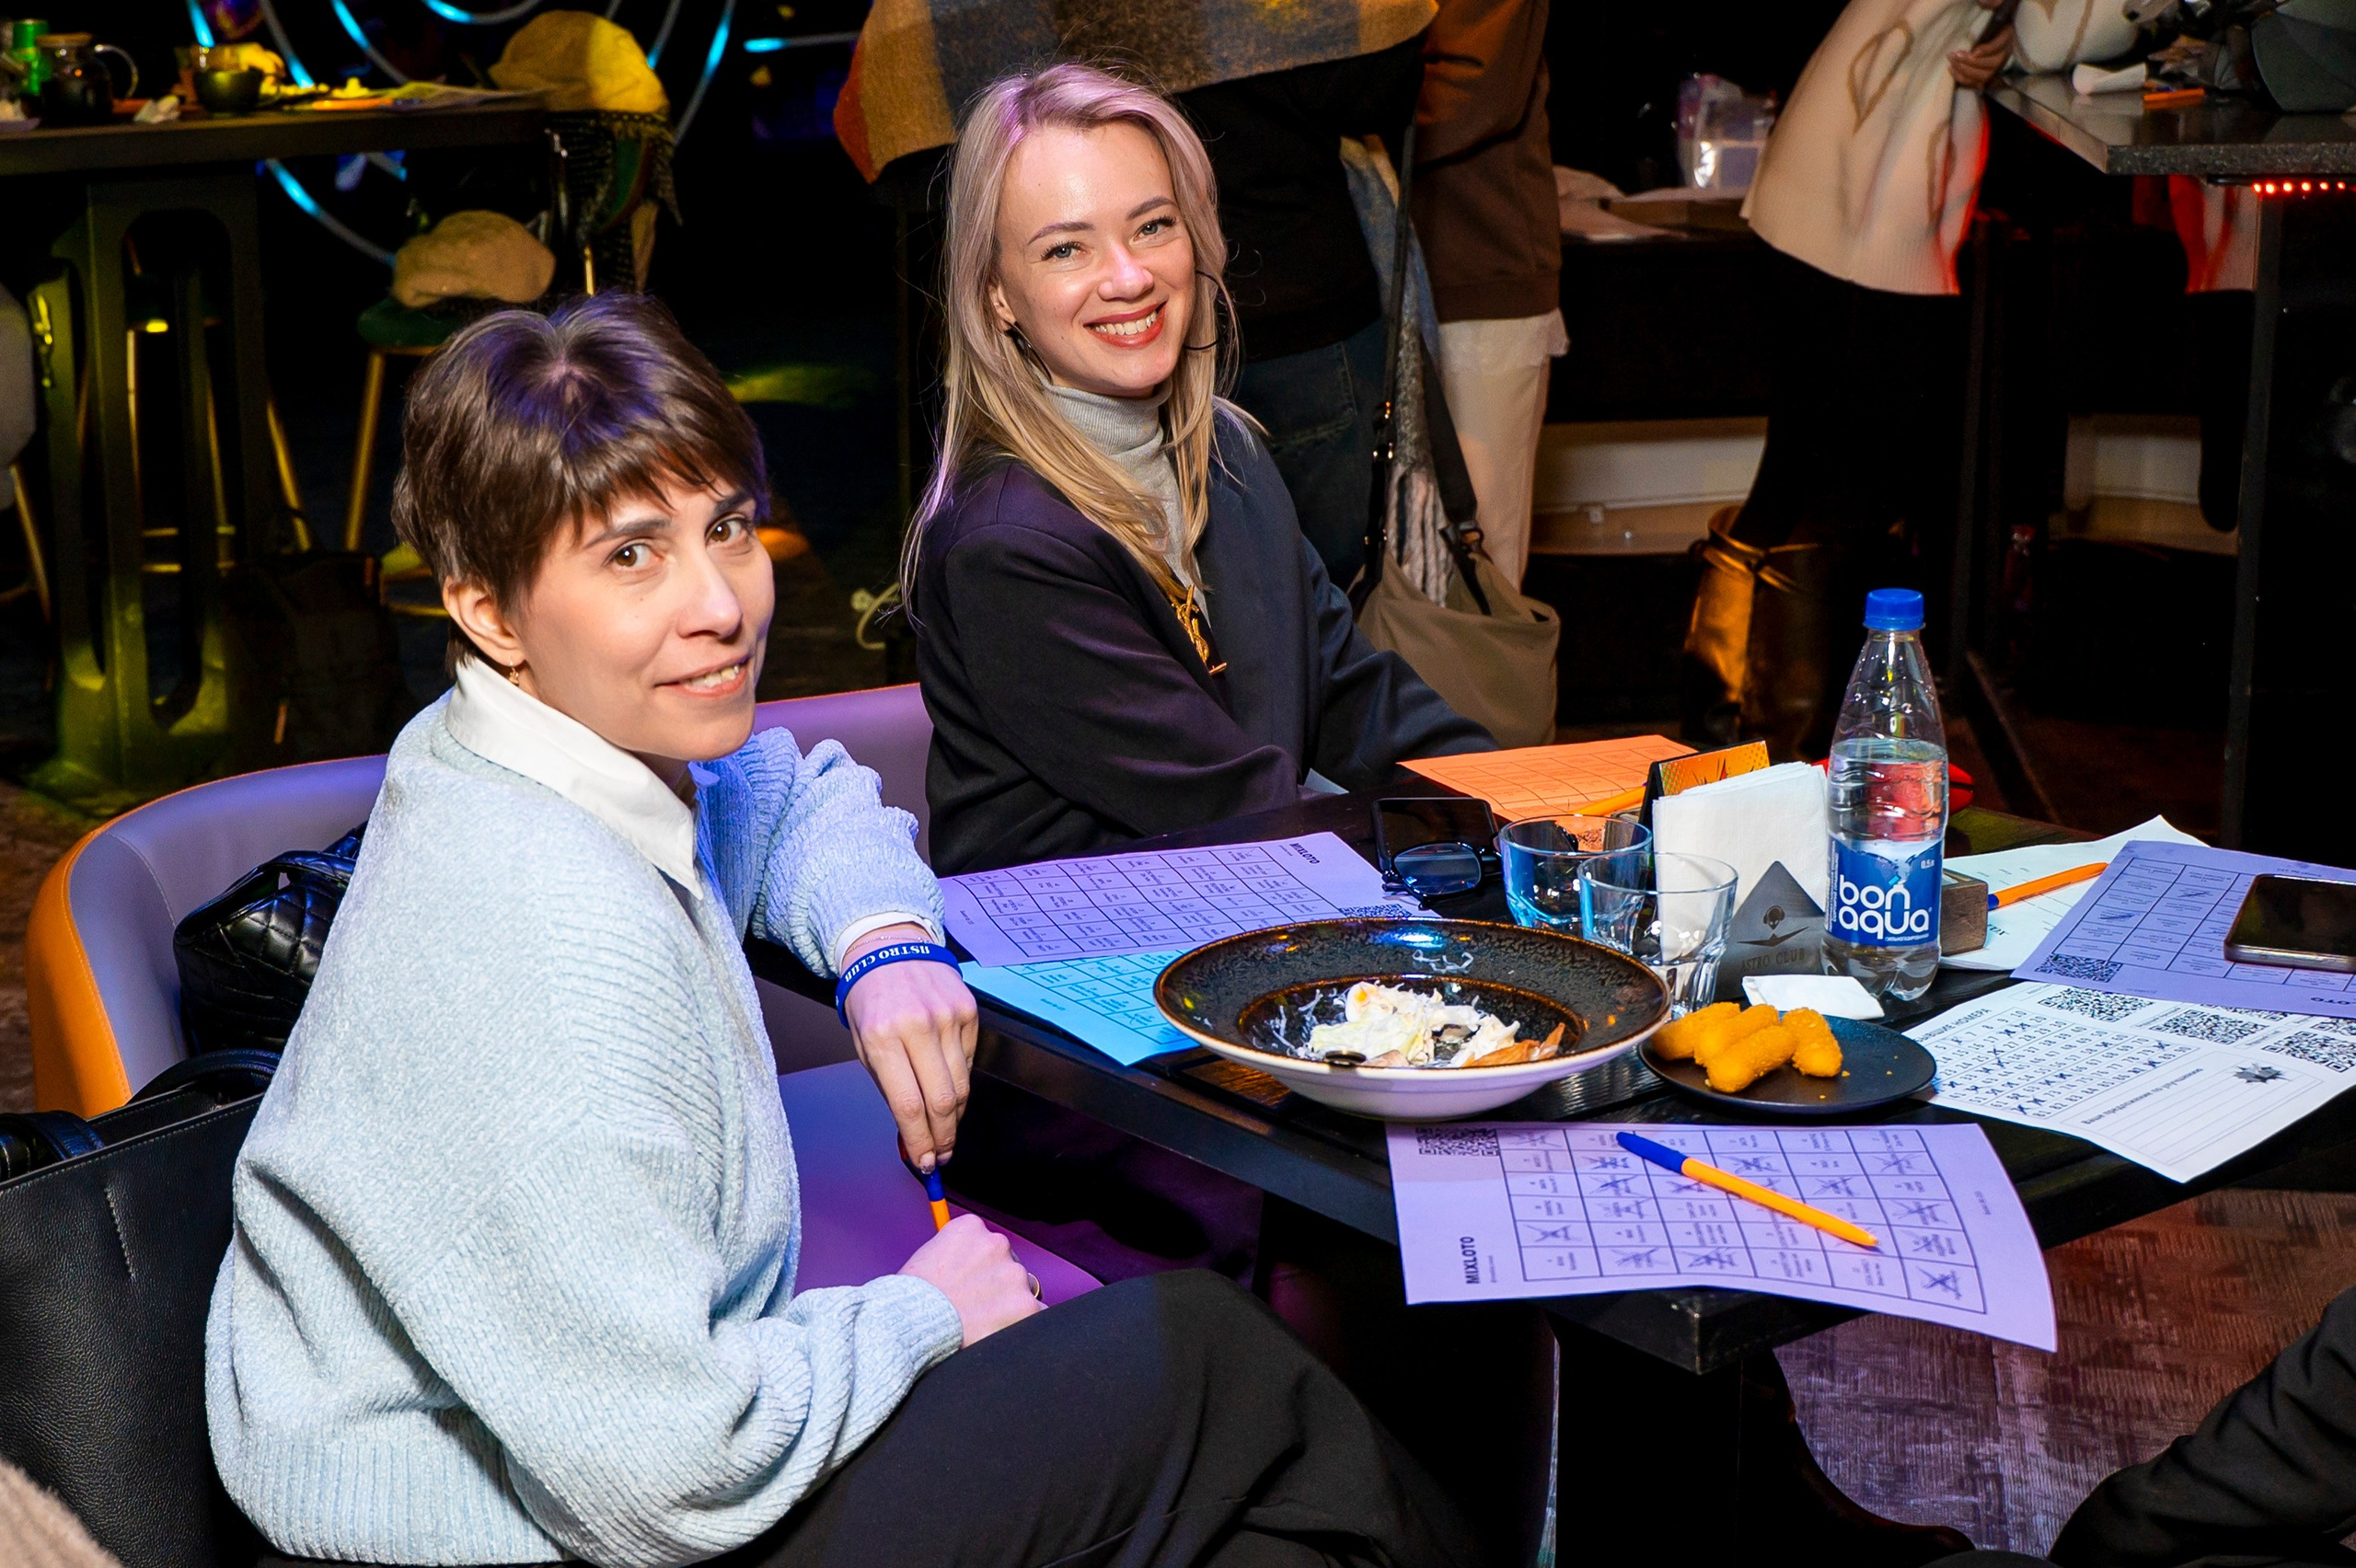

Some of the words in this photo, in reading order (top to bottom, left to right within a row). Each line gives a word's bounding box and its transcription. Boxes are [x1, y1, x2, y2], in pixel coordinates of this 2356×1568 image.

[1288, 842, 1320, 864] MIXLOTO
[1839, 874, 1911, 910] bon
[1838, 905, 1930, 940] aqua
[1739, 954, 1771, 974] ASTRO
[1775, 947, 1805, 965] CLUB
[1460, 1236, 1480, 1285] MIXLOTO
